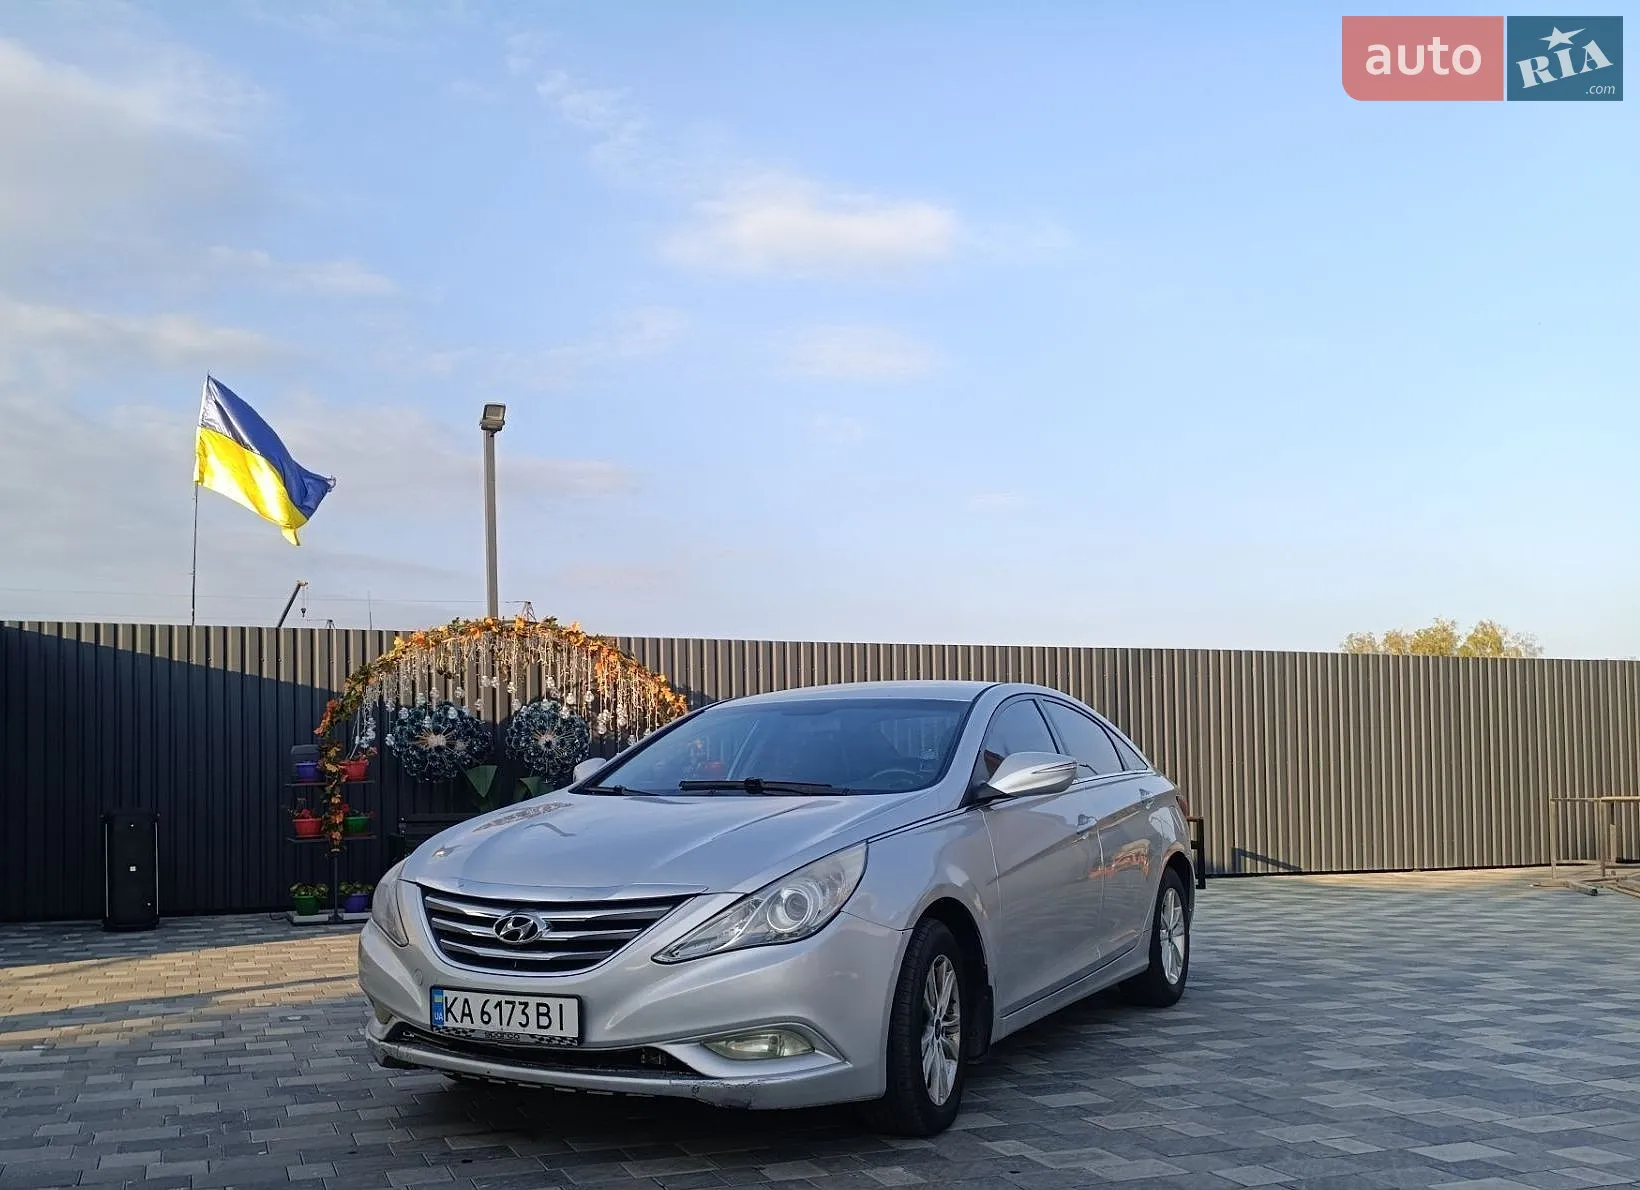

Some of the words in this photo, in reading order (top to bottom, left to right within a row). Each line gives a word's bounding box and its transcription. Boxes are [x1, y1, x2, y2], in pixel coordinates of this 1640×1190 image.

[434, 1012, 443, 1021] UA
[444, 996, 474, 1024] KA
[480, 999, 530, 1028] 6173
[536, 1003, 563, 1031] BI
